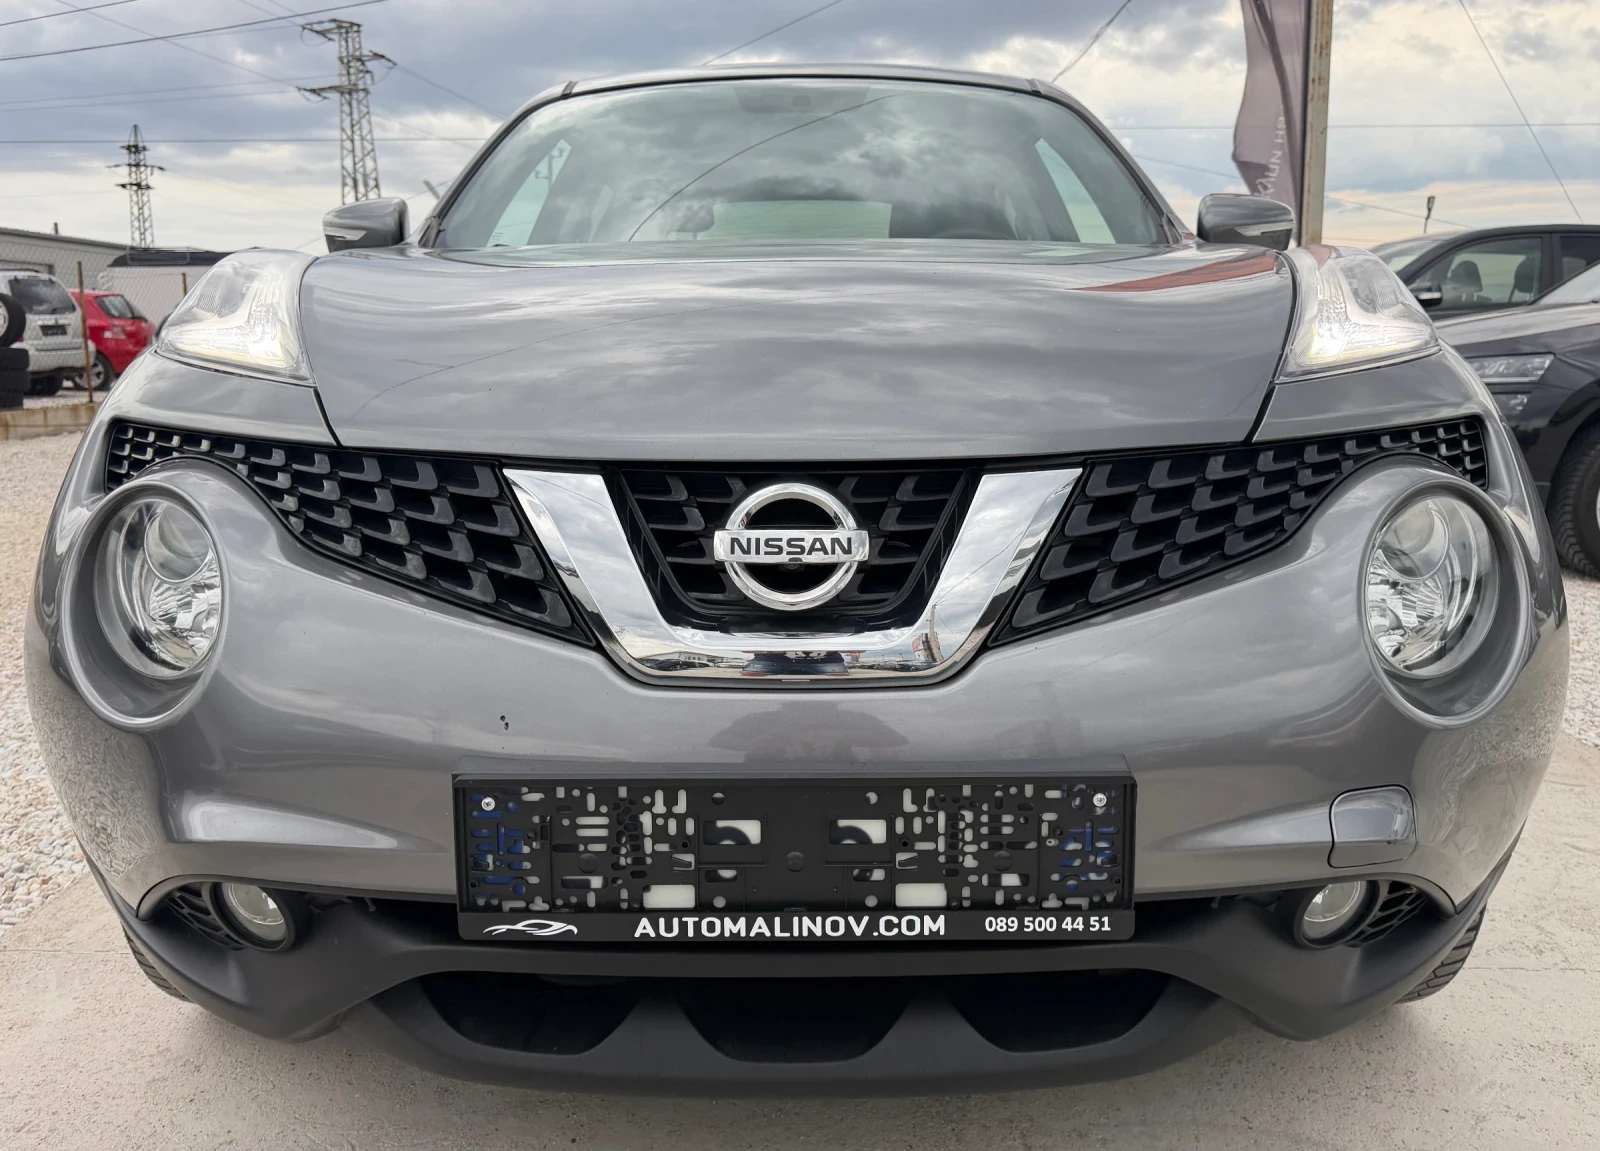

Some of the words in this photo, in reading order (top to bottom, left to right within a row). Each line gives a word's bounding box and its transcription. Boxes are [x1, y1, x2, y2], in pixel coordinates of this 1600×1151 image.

[730, 537, 852, 556] NISSAN
[633, 915, 945, 938] AUTOMALINOV.COM
[984, 916, 1019, 932] 089
[1023, 916, 1057, 932] 500
[1061, 916, 1085, 932] 44
[1089, 916, 1111, 932] 51
